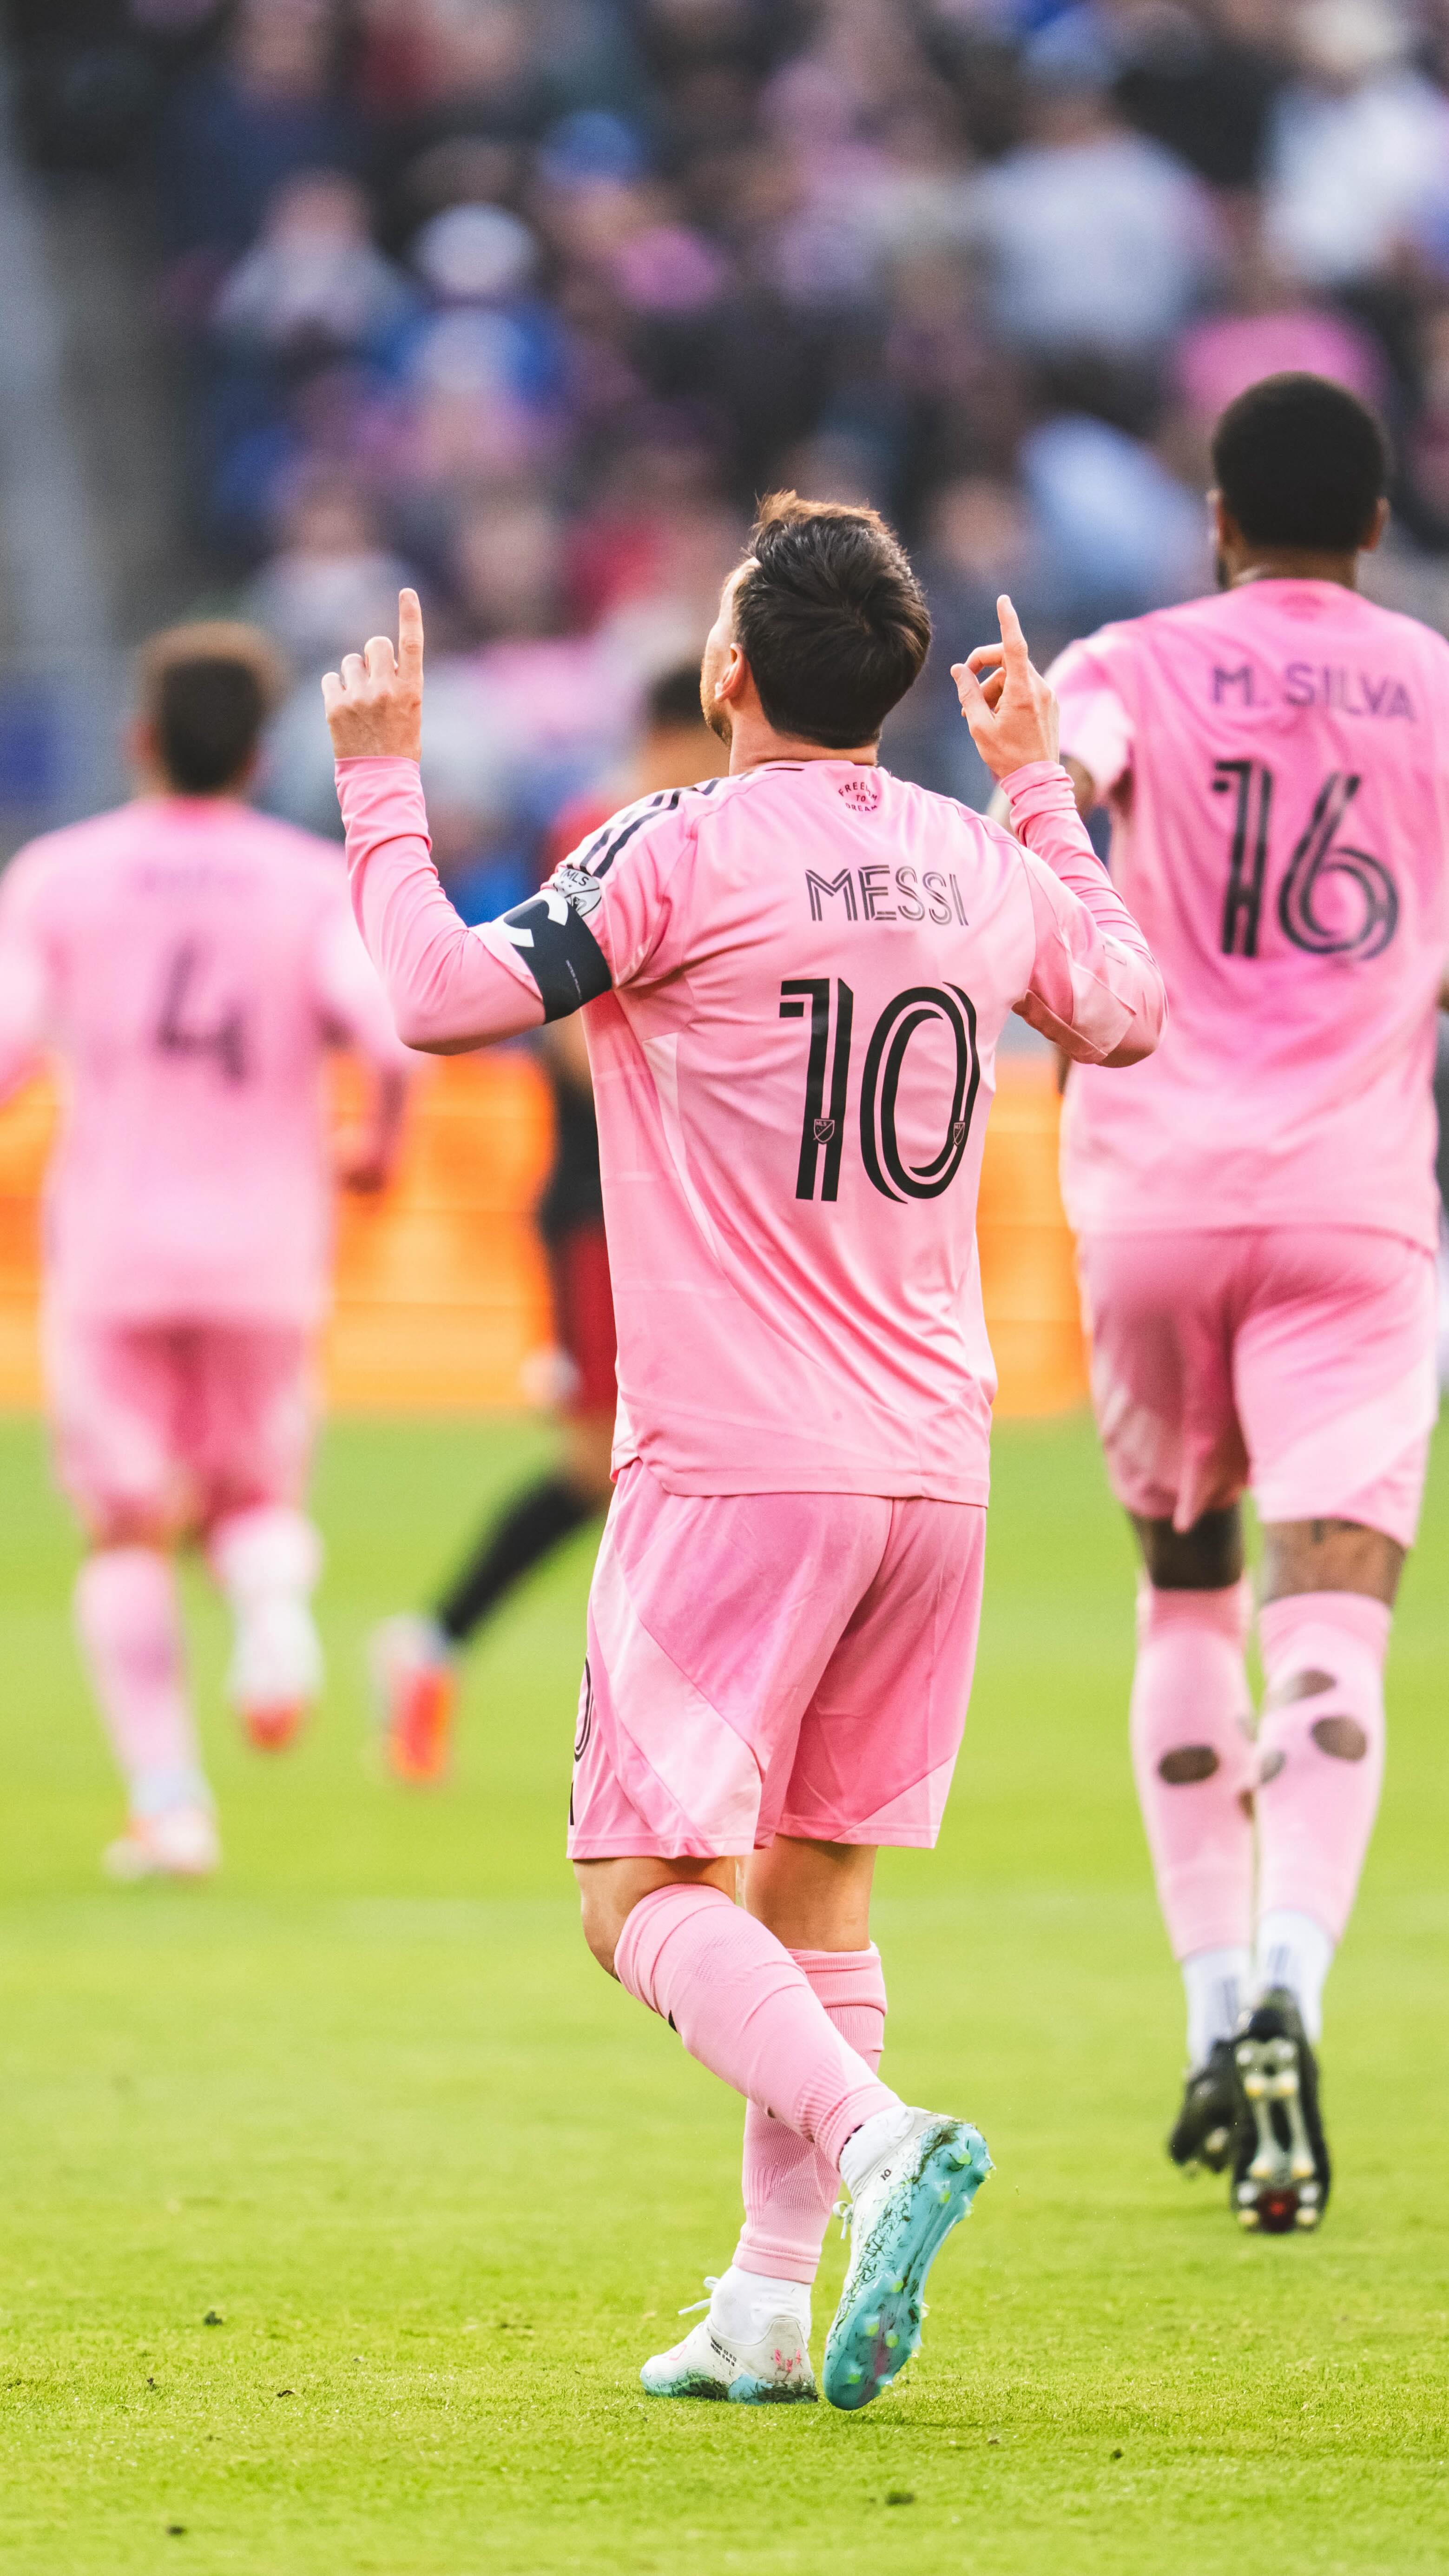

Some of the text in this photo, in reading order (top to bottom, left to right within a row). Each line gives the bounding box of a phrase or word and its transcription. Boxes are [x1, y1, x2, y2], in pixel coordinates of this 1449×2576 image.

[1284, 662, 1417, 723] SILVA
[563, 870, 589, 886] MLS
[1212, 759, 1400, 962] 16
[805, 865, 969, 926] MESSI
[155, 933, 250, 1089] 4
[779, 977, 981, 1204] 10
[880, 2169, 892, 2181] 10
